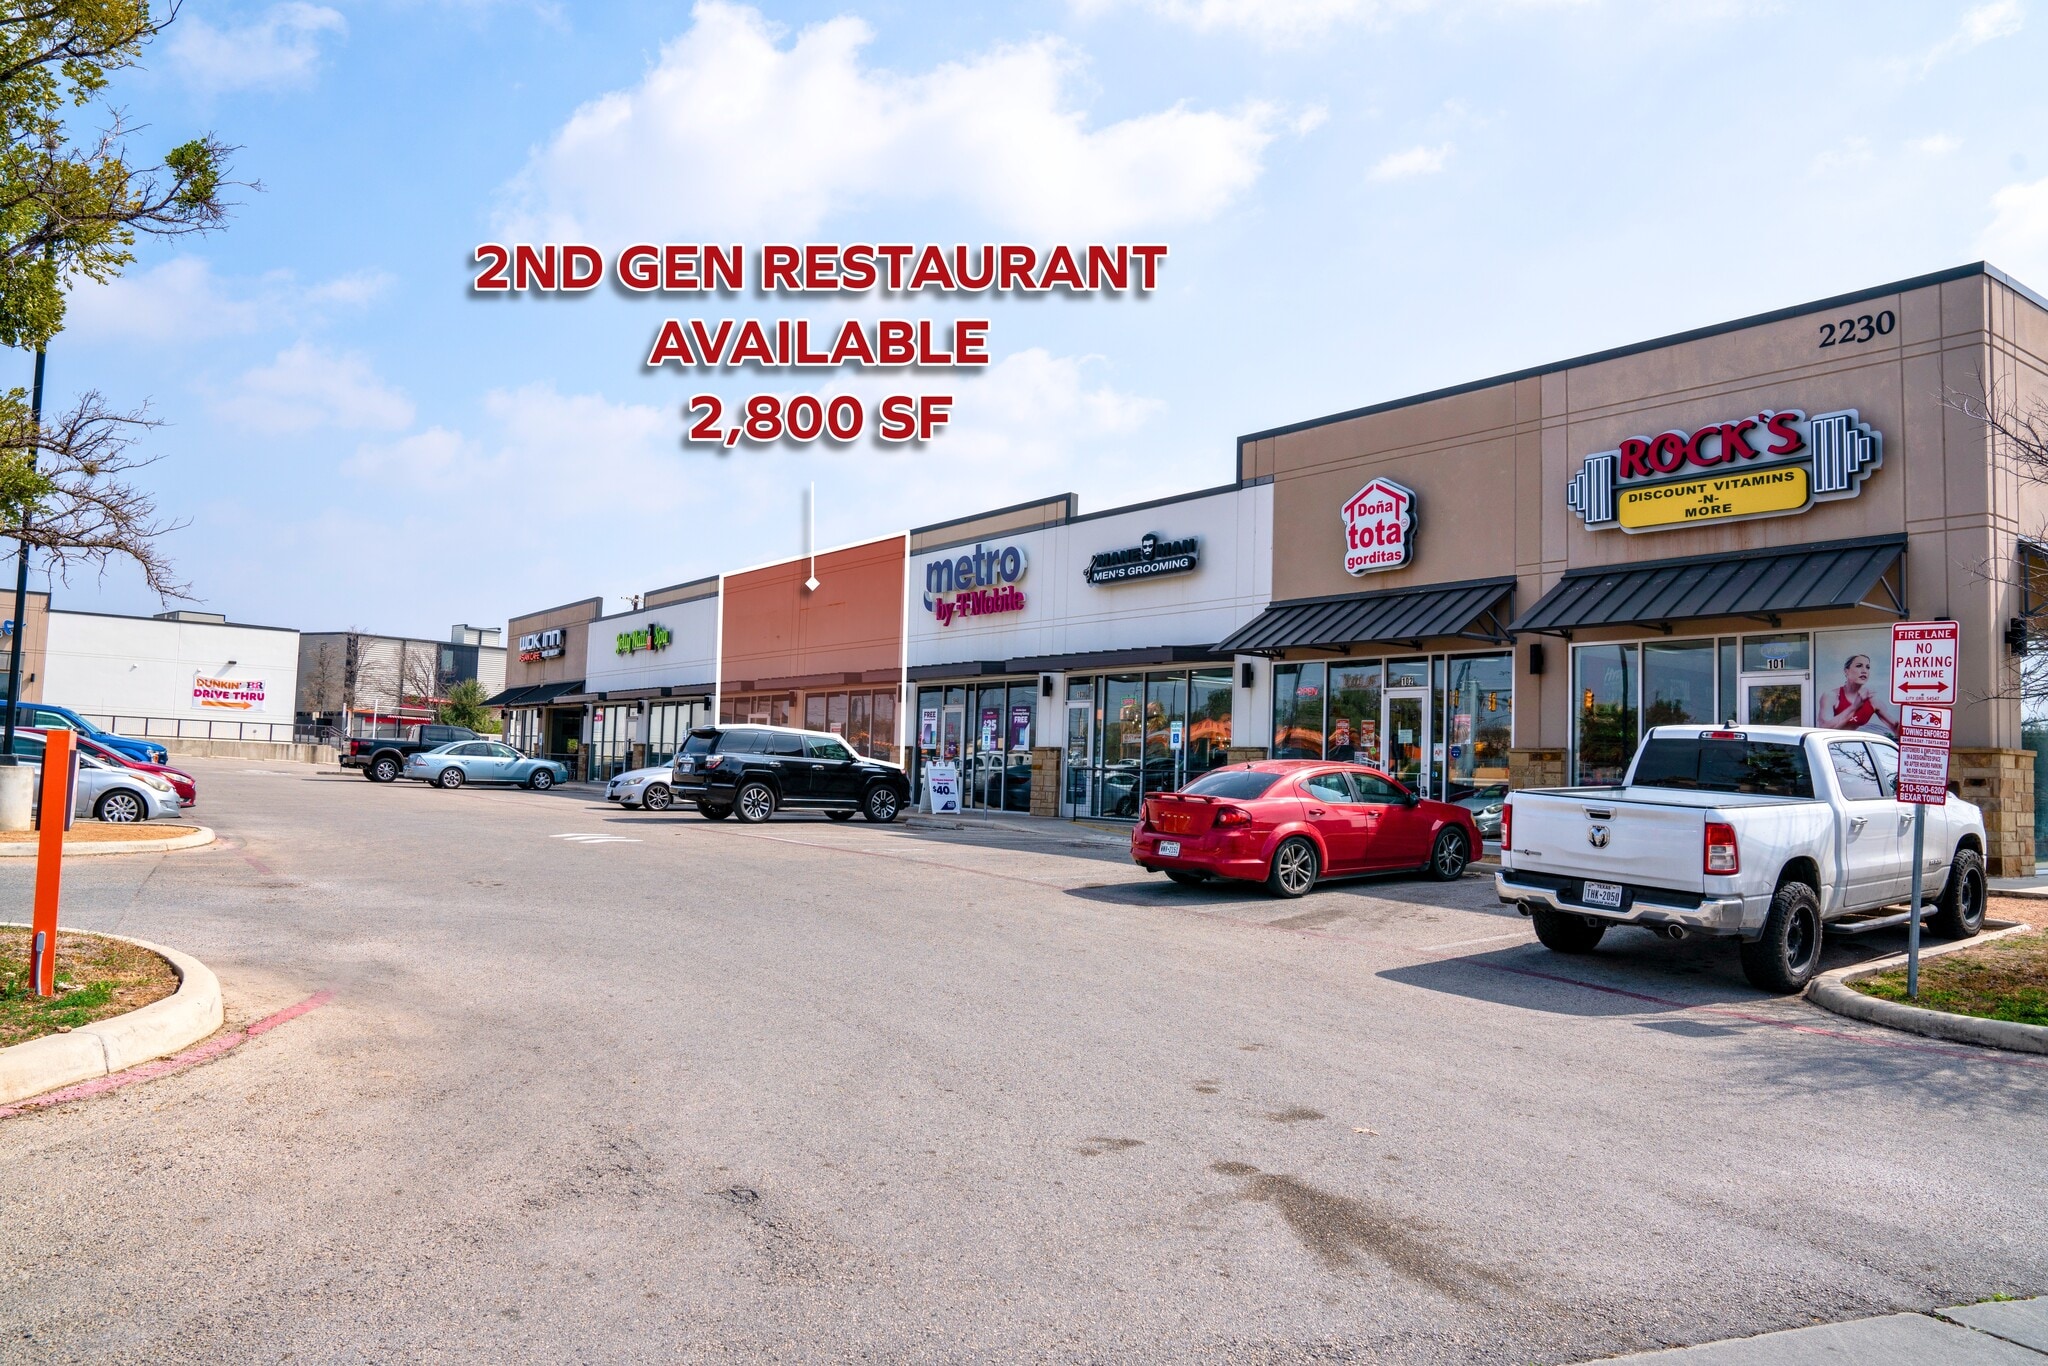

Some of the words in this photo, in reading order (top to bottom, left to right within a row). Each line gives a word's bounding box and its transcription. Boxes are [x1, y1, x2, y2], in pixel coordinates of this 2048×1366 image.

[1818, 310, 1896, 348] 2230
[1619, 412, 1806, 478] ROCK'S
[1628, 484, 1708, 503] DISCOUNT
[1713, 471, 1795, 491] VITAMINS
[1698, 494, 1719, 504] -N-
[1358, 500, 1393, 517] Doña
[1684, 503, 1732, 518] MORE
[1348, 518, 1401, 550] tota
[1096, 547, 1142, 568] MANE
[1156, 538, 1195, 557] MAN
[1347, 550, 1402, 570] gorditas
[926, 543, 1021, 594] metro
[1093, 568, 1125, 581] MEN'S
[1127, 557, 1189, 576] GROOMING
[936, 597, 956, 627] by
[654, 627, 670, 649] Spa
[1898, 630, 1921, 639] FIRE
[1925, 629, 1951, 639] LANE
[519, 632, 541, 651] WOK
[1916, 642, 1933, 654] NO
[1768, 658, 1784, 669] 101
[1896, 656, 1952, 668] PARKING
[1903, 670, 1944, 678] ANYTIME
[196, 678, 242, 689] DUNKIN'
[1401, 676, 1414, 686] 102
[233, 692, 265, 701] THRU
[1296, 687, 1318, 696] OPEN
[1902, 727, 1924, 737] TOWING
[1924, 729, 1950, 739] ENFORCED
[932, 785, 950, 795] $40
[1900, 784, 1945, 795] 210-590-6200
[1900, 793, 1922, 801] BEXAR
[1922, 794, 1944, 804] TOWING
